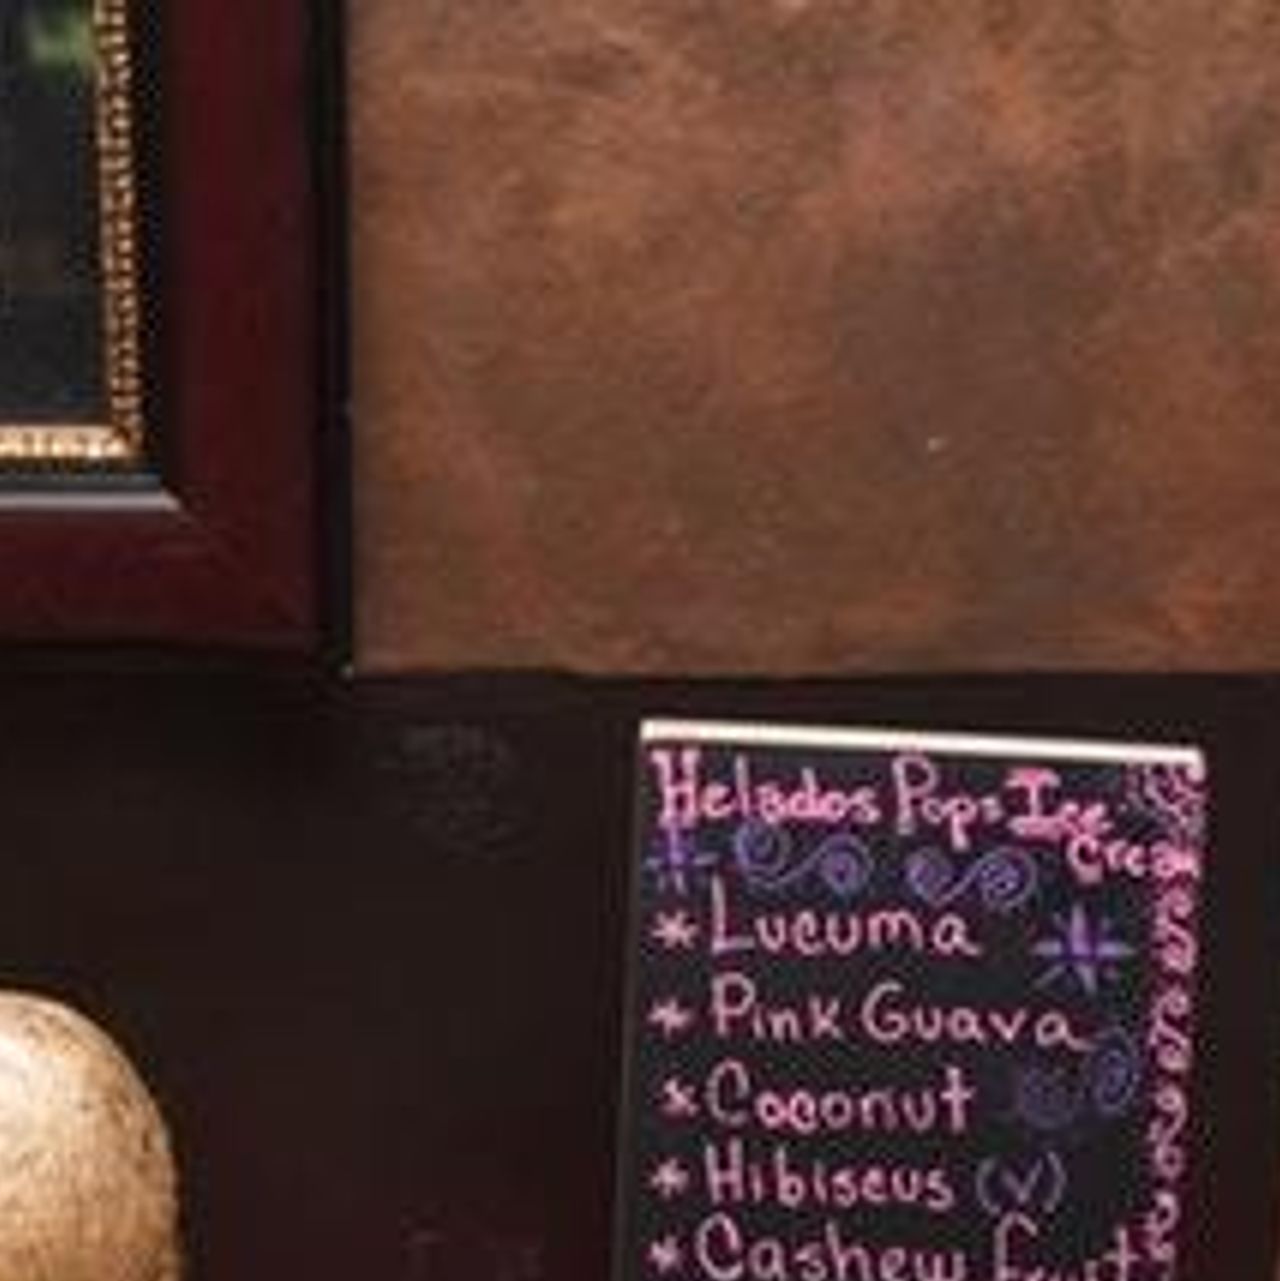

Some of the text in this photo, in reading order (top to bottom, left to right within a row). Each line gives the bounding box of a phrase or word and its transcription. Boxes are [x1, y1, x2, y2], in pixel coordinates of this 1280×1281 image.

[711, 970, 1094, 1052] Pink Guava
[705, 1059, 977, 1130] Coconut
[705, 1143, 955, 1209] Hibiscus
